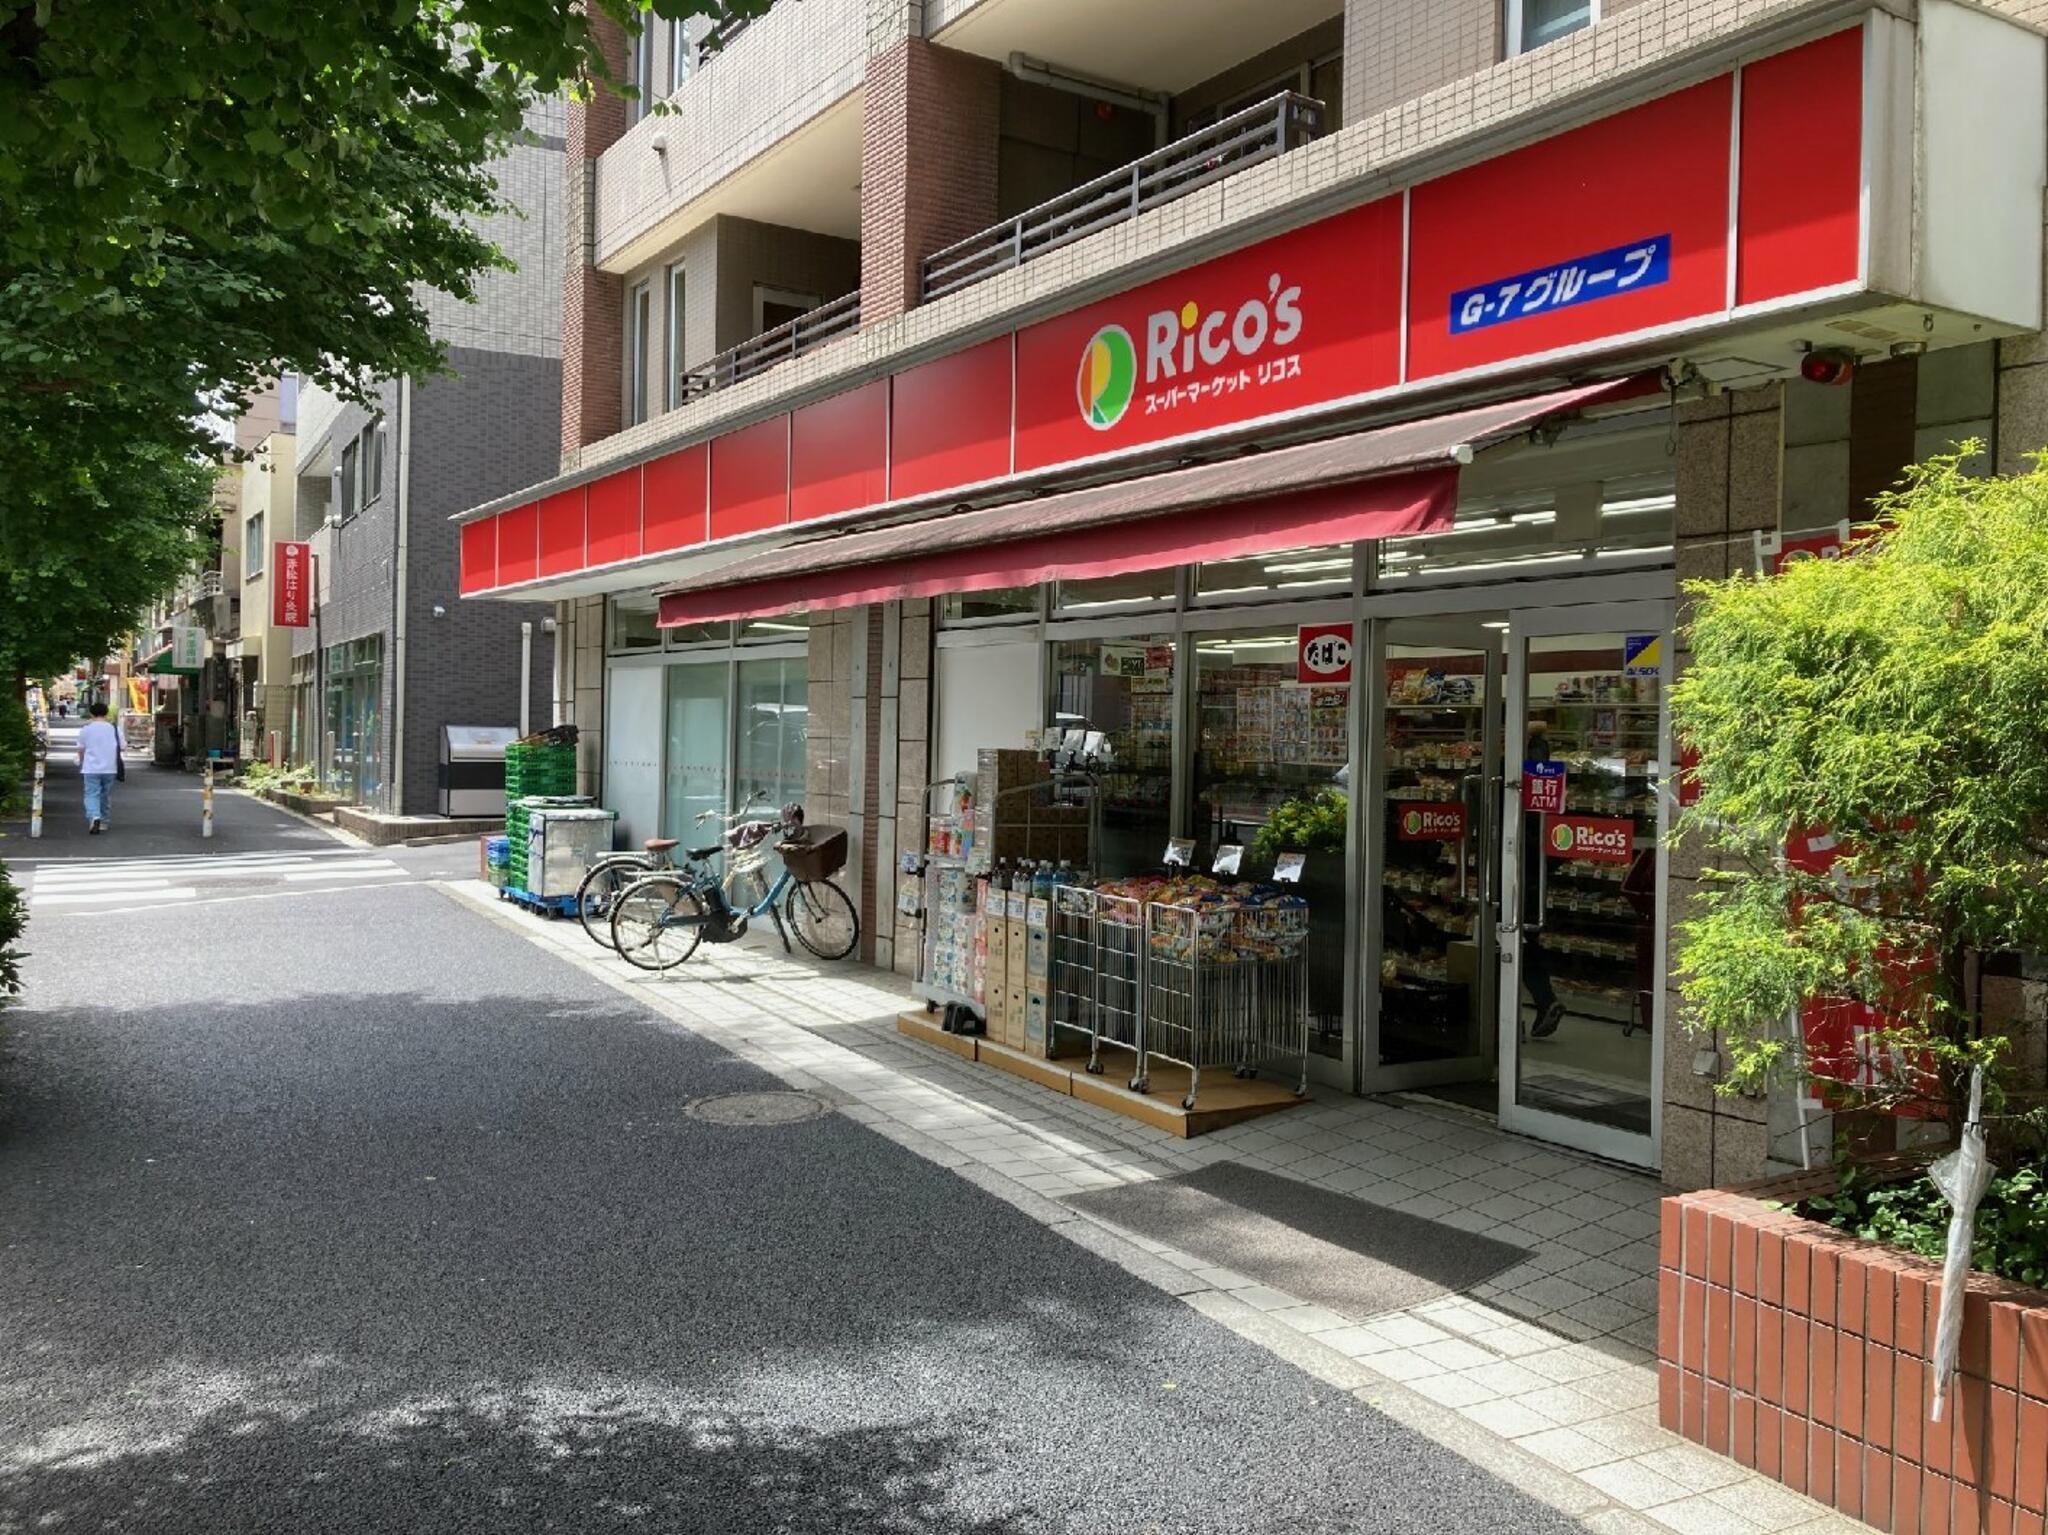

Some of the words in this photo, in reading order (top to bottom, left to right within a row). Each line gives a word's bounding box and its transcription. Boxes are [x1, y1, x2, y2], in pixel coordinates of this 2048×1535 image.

[1460, 244, 1656, 325] G-7グループ
[1146, 273, 1302, 383] Rico's
[1145, 369, 1250, 415] スーパーマーケット
[1258, 354, 1301, 385] リコス
[1307, 640, 1347, 666] たばこ
[1626, 666, 1660, 676] ALSOK
[1531, 778, 1558, 796] 銀行
[1530, 796, 1558, 808] ATM
[1423, 811, 1461, 827] Rico's
[1576, 826, 1626, 848] Rico's
